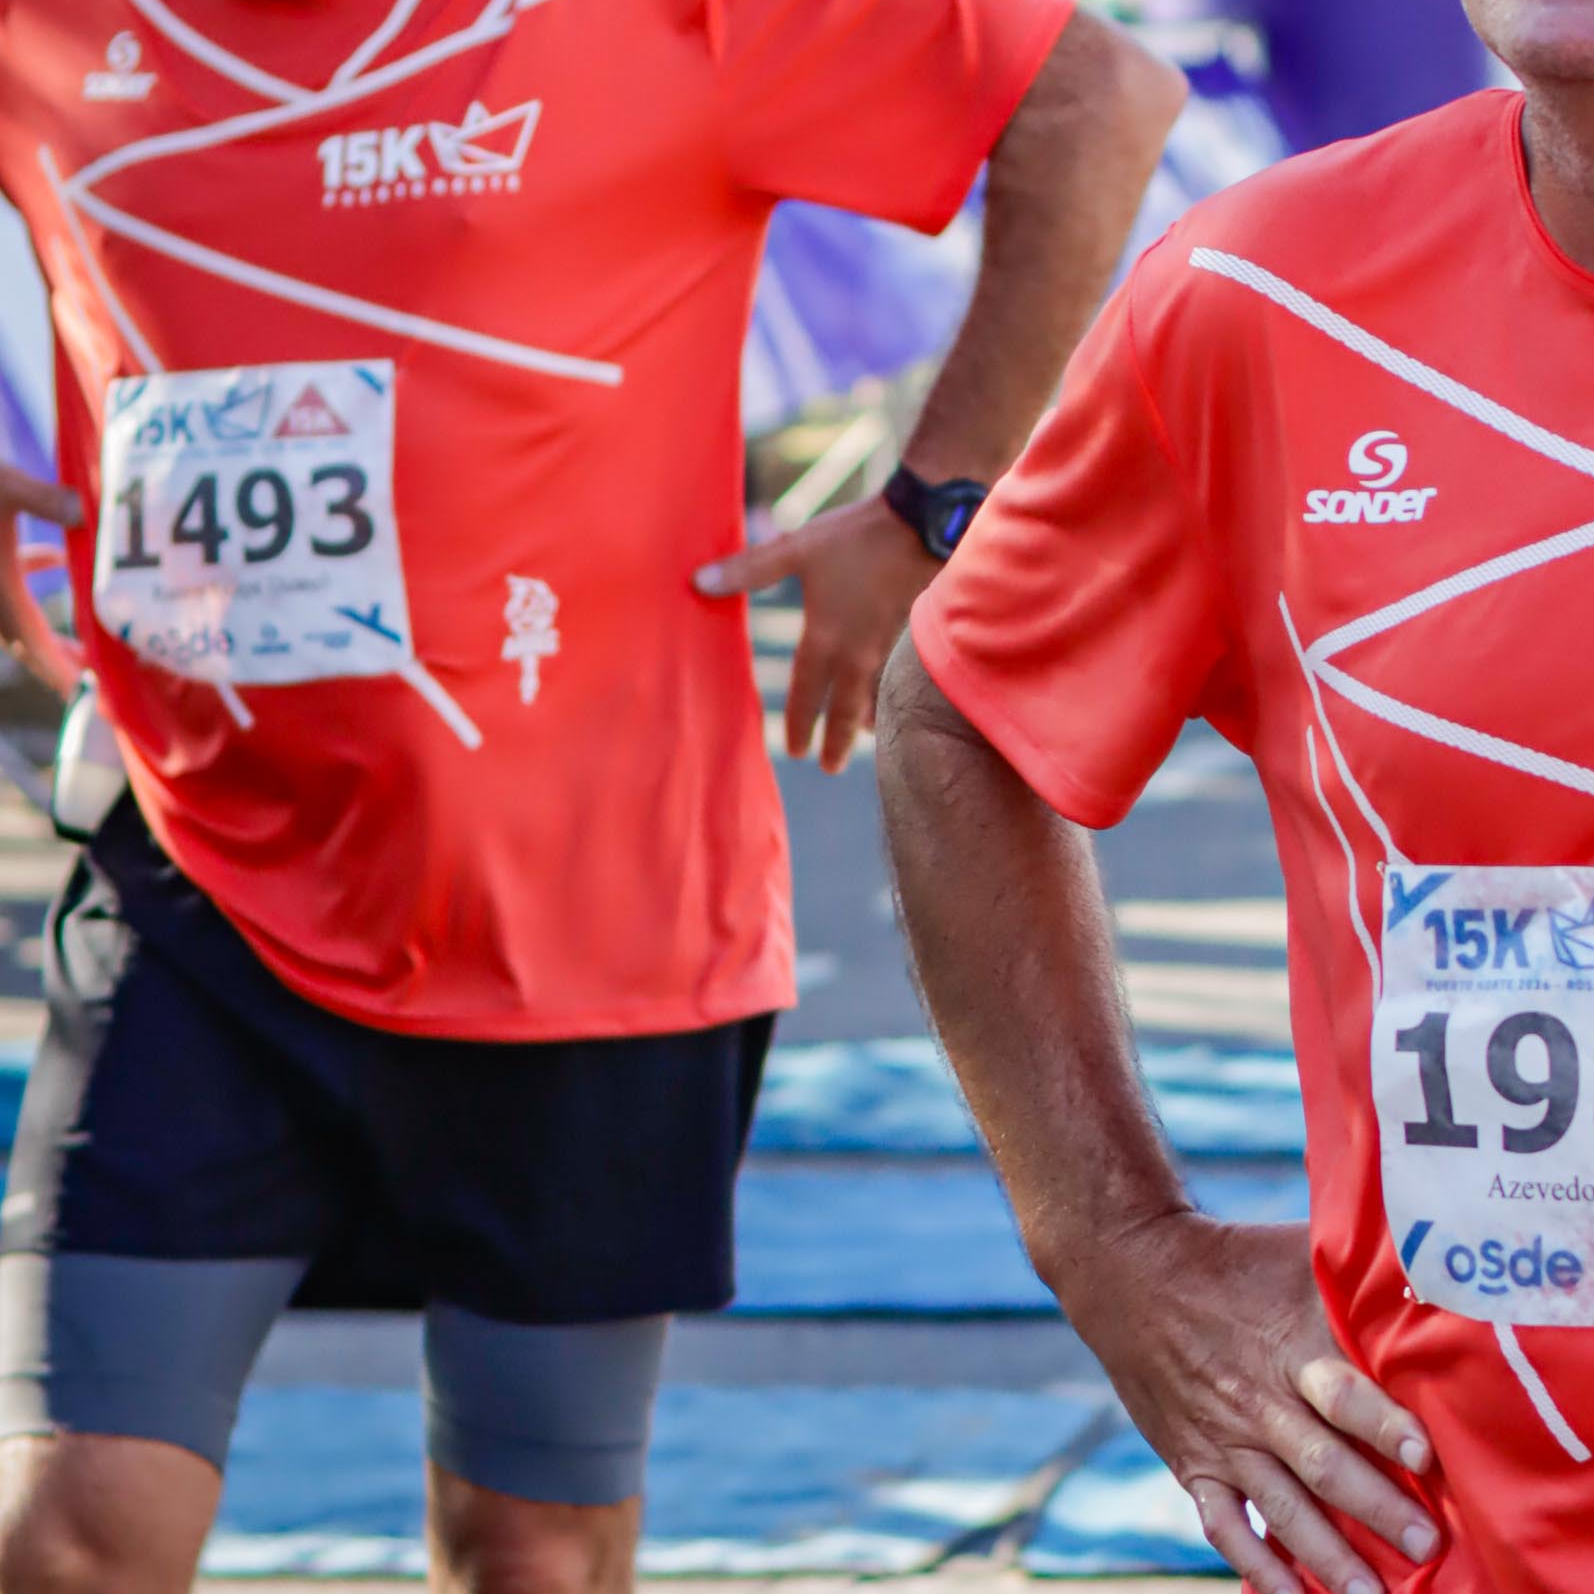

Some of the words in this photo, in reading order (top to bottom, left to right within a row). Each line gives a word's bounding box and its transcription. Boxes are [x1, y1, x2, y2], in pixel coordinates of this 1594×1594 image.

[317, 123, 427, 191] 15K
[113, 462, 376, 571] 1493
[1422, 907, 1539, 971] 15K
[1444, 1234, 1584, 1291] osde
